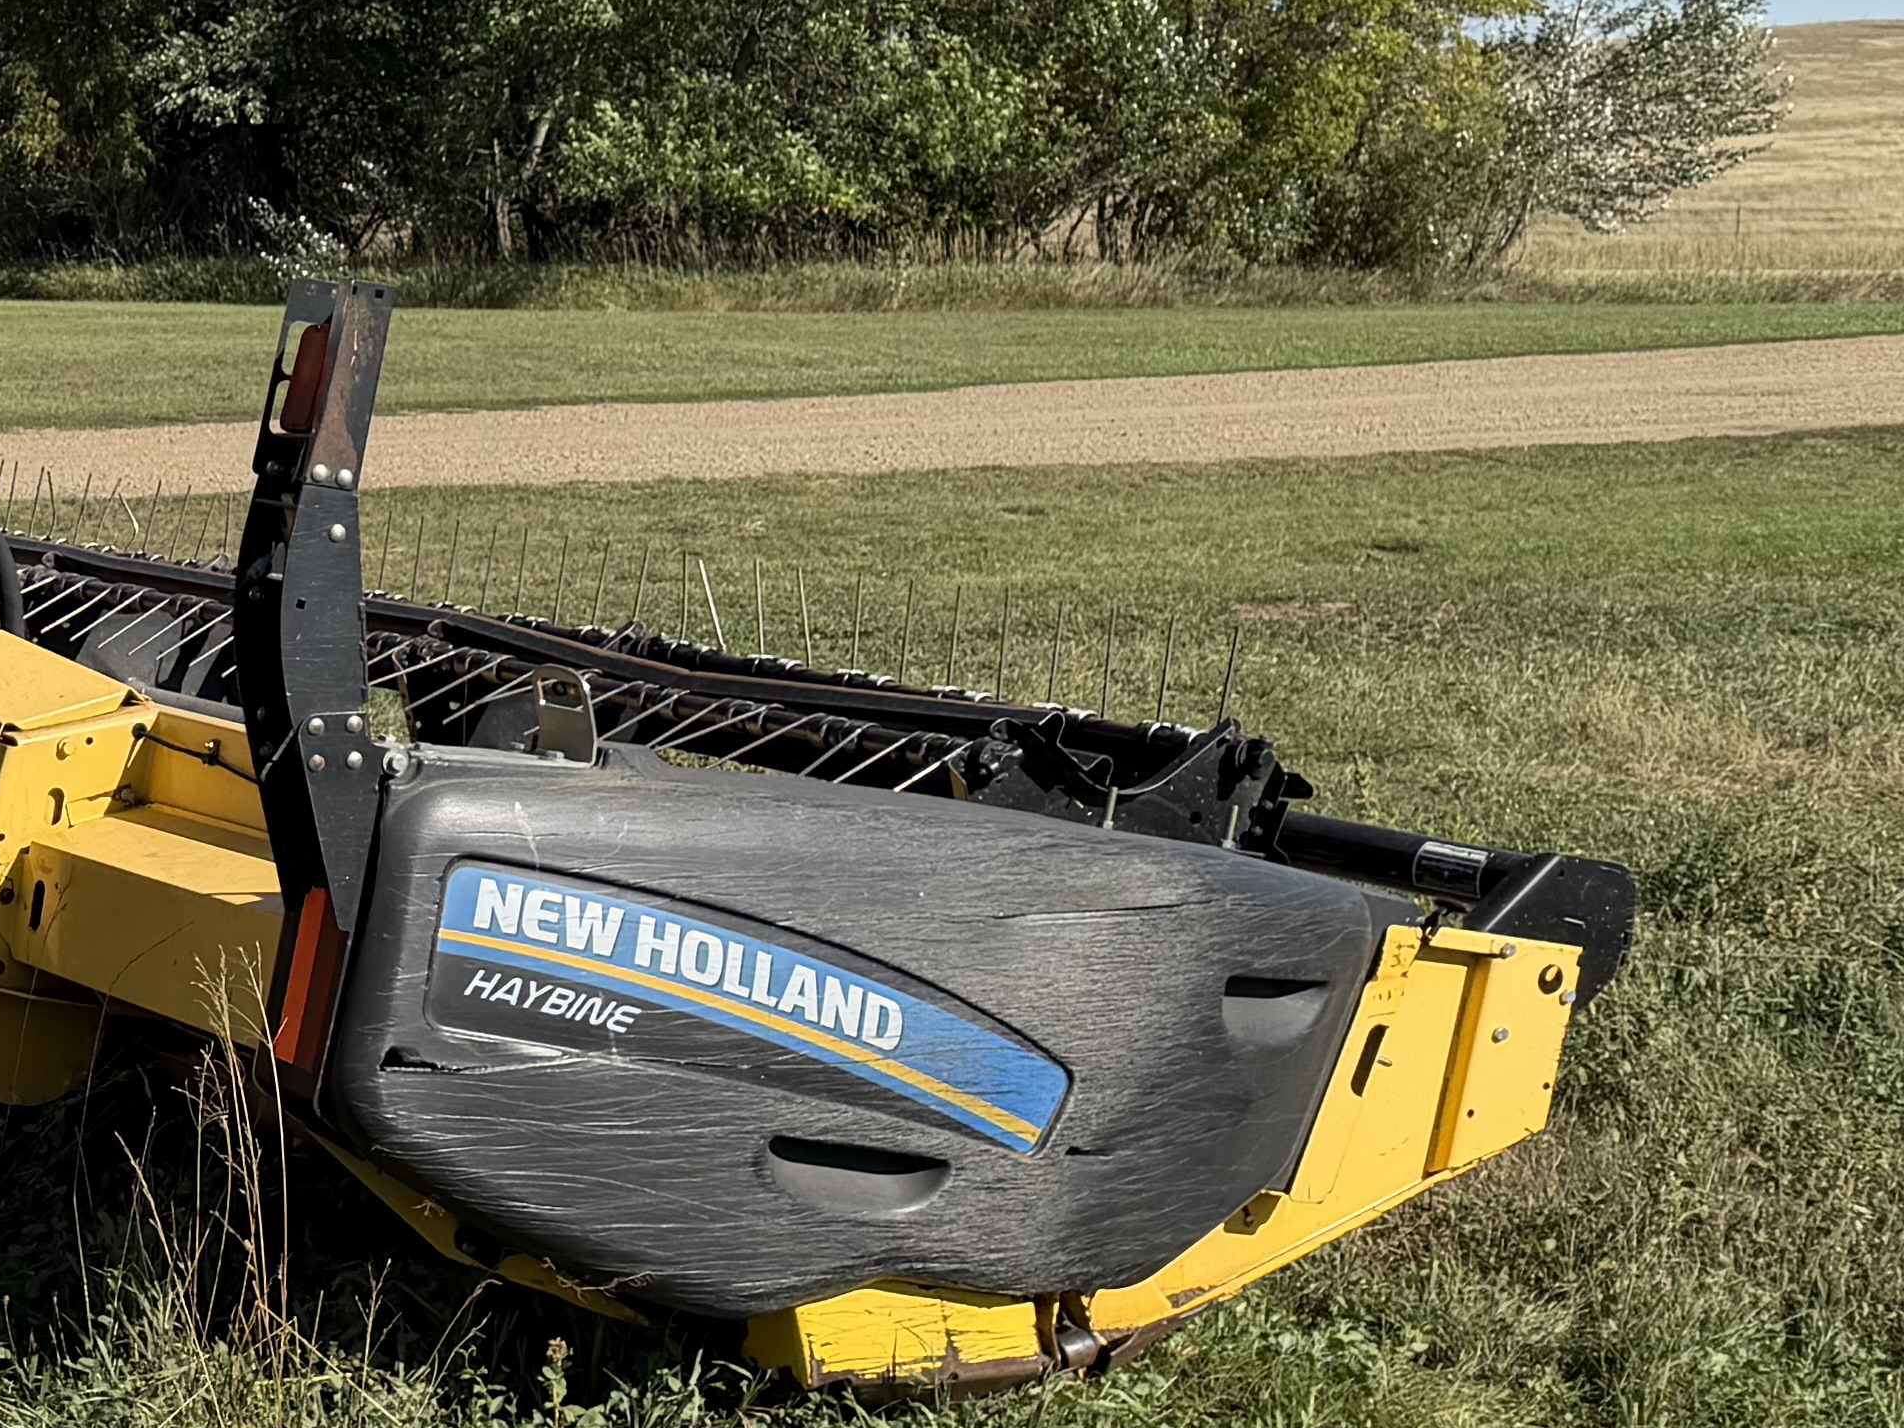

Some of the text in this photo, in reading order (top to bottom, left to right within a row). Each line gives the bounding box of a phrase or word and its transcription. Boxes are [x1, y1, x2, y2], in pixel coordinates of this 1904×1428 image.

[462, 969, 642, 1035] HAYBINE
[472, 877, 906, 1051] NEW HOLLAND
